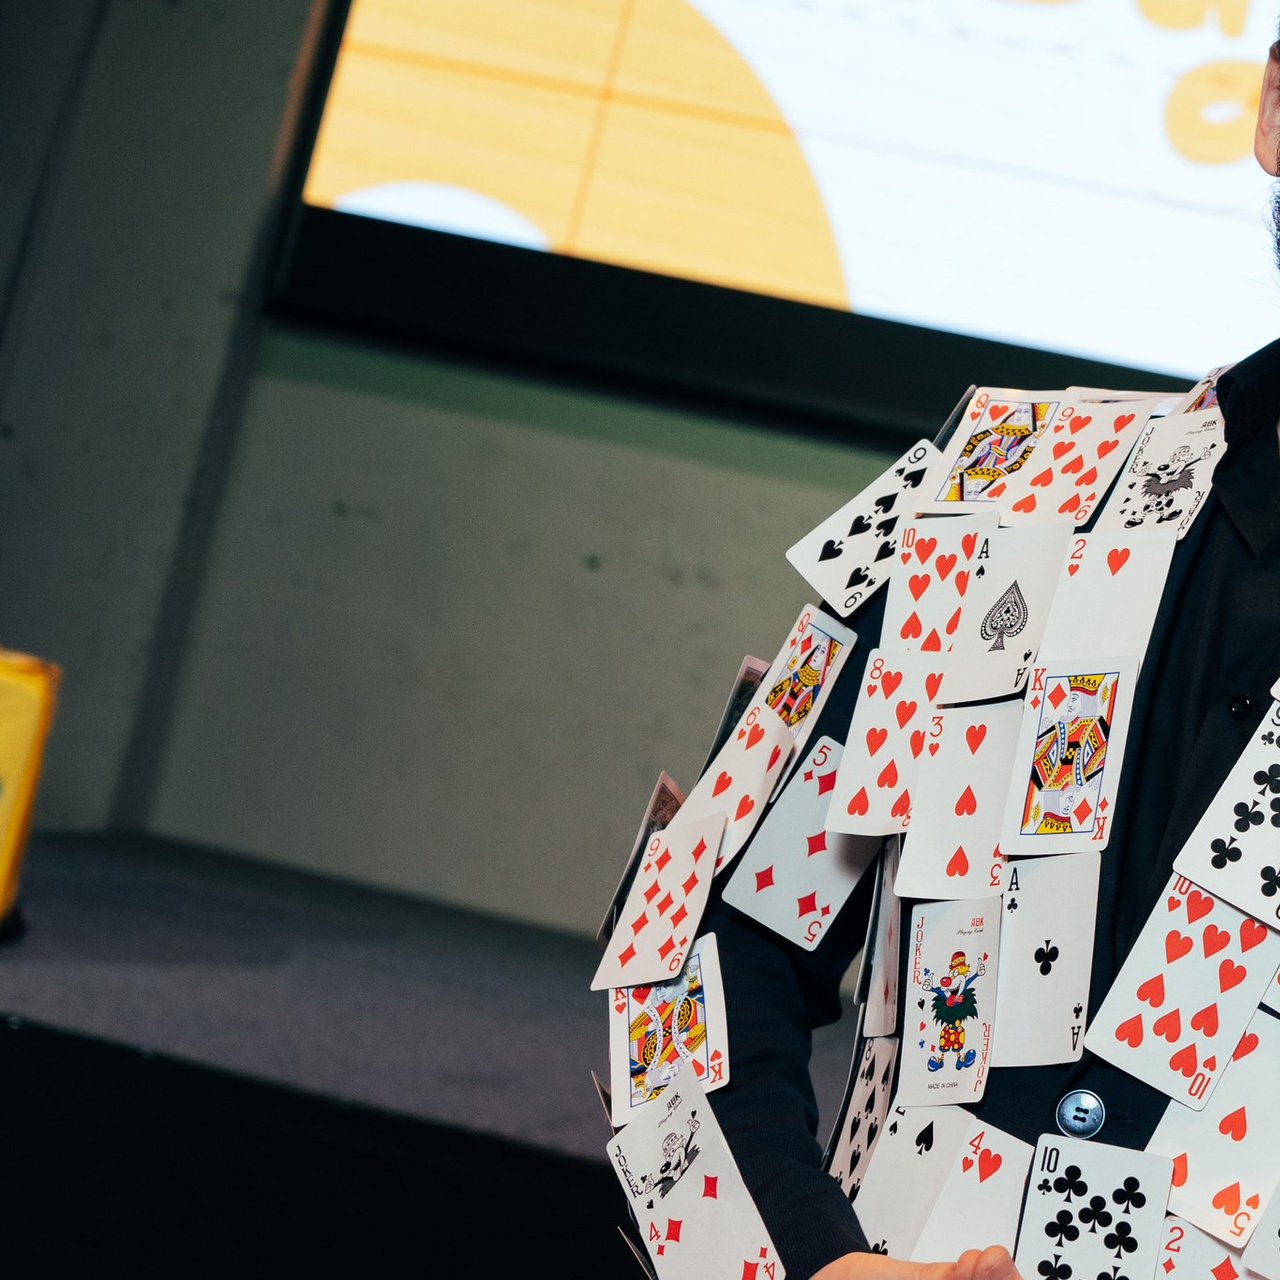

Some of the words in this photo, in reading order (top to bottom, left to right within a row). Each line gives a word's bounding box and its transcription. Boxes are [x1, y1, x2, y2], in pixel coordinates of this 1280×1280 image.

[976, 394, 989, 409] Q
[1059, 407, 1074, 421] 9
[902, 528, 916, 548] 10
[978, 538, 989, 559] A
[1071, 539, 1086, 559] 2
[798, 613, 810, 634] Q
[870, 658, 884, 680] 8
[1014, 667, 1027, 687] A
[1031, 668, 1046, 691] K
[746, 707, 760, 726] 6
[930, 716, 943, 737] 3
[813, 745, 831, 766] 5
[1092, 817, 1108, 840] K
[990, 864, 1002, 886] 3
[1008, 867, 1020, 891] A
[804, 921, 822, 942] 5
[913, 916, 924, 984] JOKER
[1071, 1026, 1081, 1051] A
[974, 1022, 990, 1092] JOKER
[710, 1062, 723, 1083] K
[1188, 1073, 1211, 1100] 10
[969, 1131, 985, 1155] 4
[1041, 1147, 1059, 1173] 10
[615, 1144, 644, 1199] JOKER
[650, 1222, 660, 1241] 4
[1230, 1212, 1250, 1237] 5
[1165, 1226, 1184, 1252] 2
